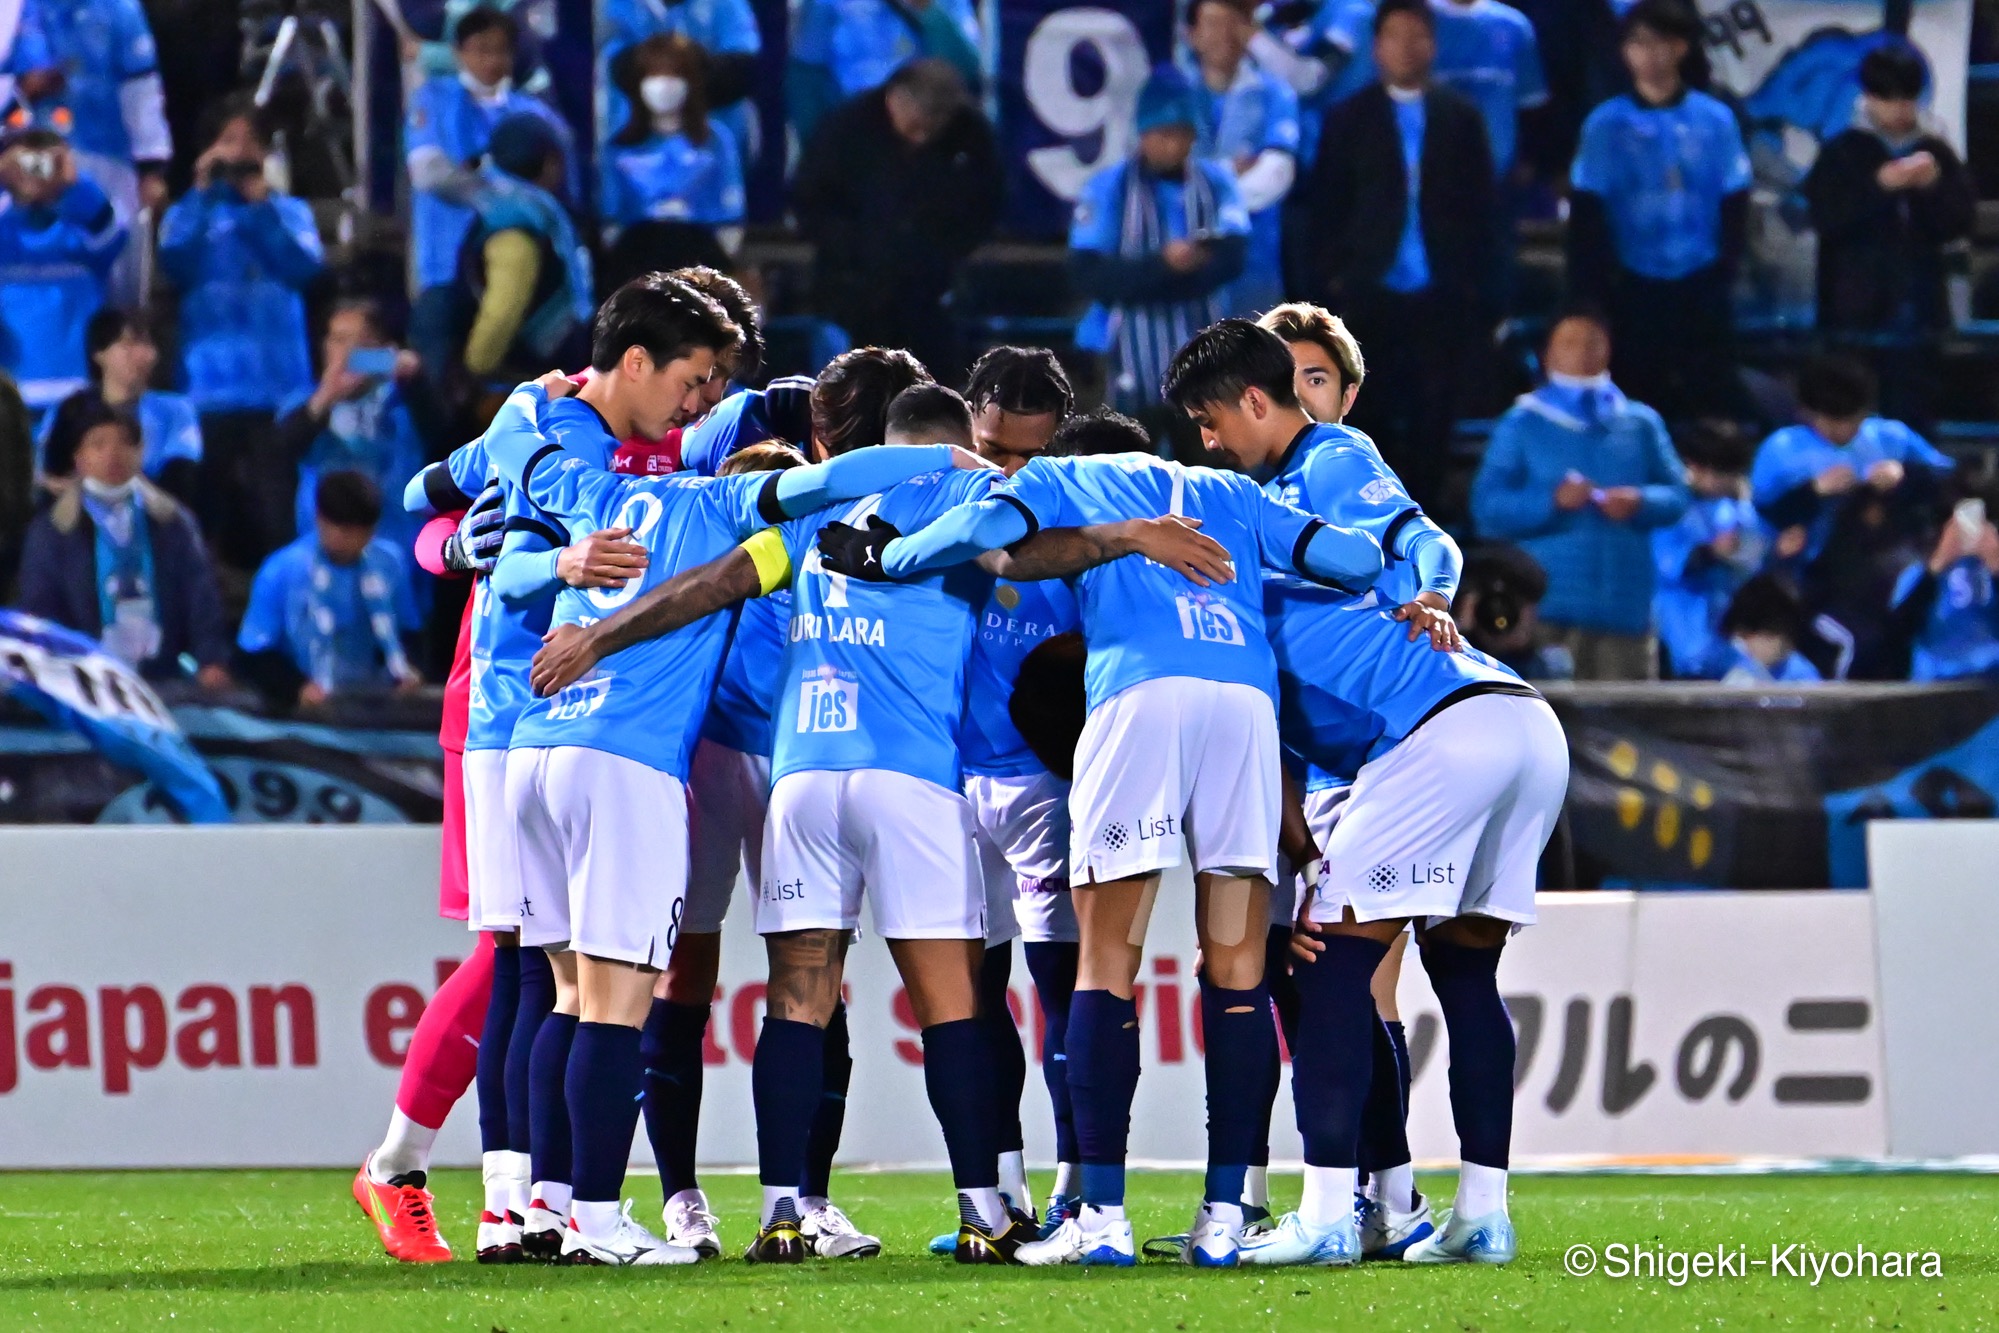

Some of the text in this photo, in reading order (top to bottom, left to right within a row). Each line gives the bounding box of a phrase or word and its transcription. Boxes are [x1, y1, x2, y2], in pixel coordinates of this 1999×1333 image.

[1023, 6, 1151, 201] 9
[827, 615, 886, 648] LARA
[806, 685, 847, 732] jes
[1138, 814, 1175, 841] List
[771, 878, 805, 901] List
[1412, 862, 1455, 885] List
[667, 896, 683, 951] 8
[0, 961, 317, 1093] japan
